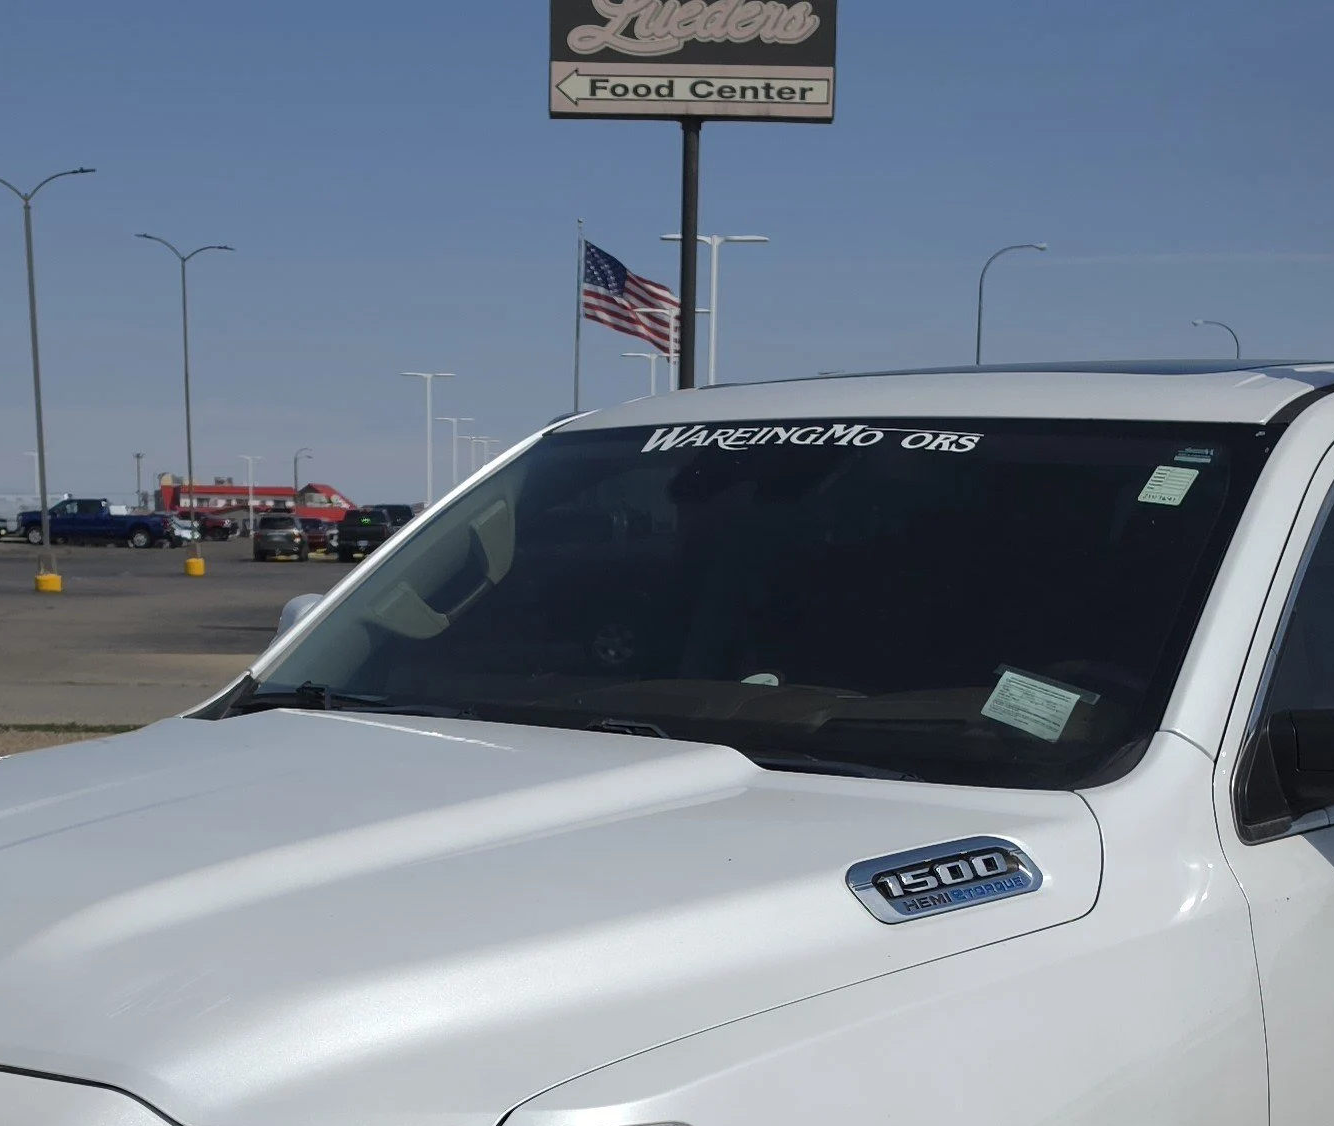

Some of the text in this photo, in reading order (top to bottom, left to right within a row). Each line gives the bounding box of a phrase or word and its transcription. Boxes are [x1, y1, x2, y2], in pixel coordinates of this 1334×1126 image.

[588, 78, 814, 101] Food Center
[878, 851, 1008, 899] 1500
[903, 891, 953, 912] HEMI
